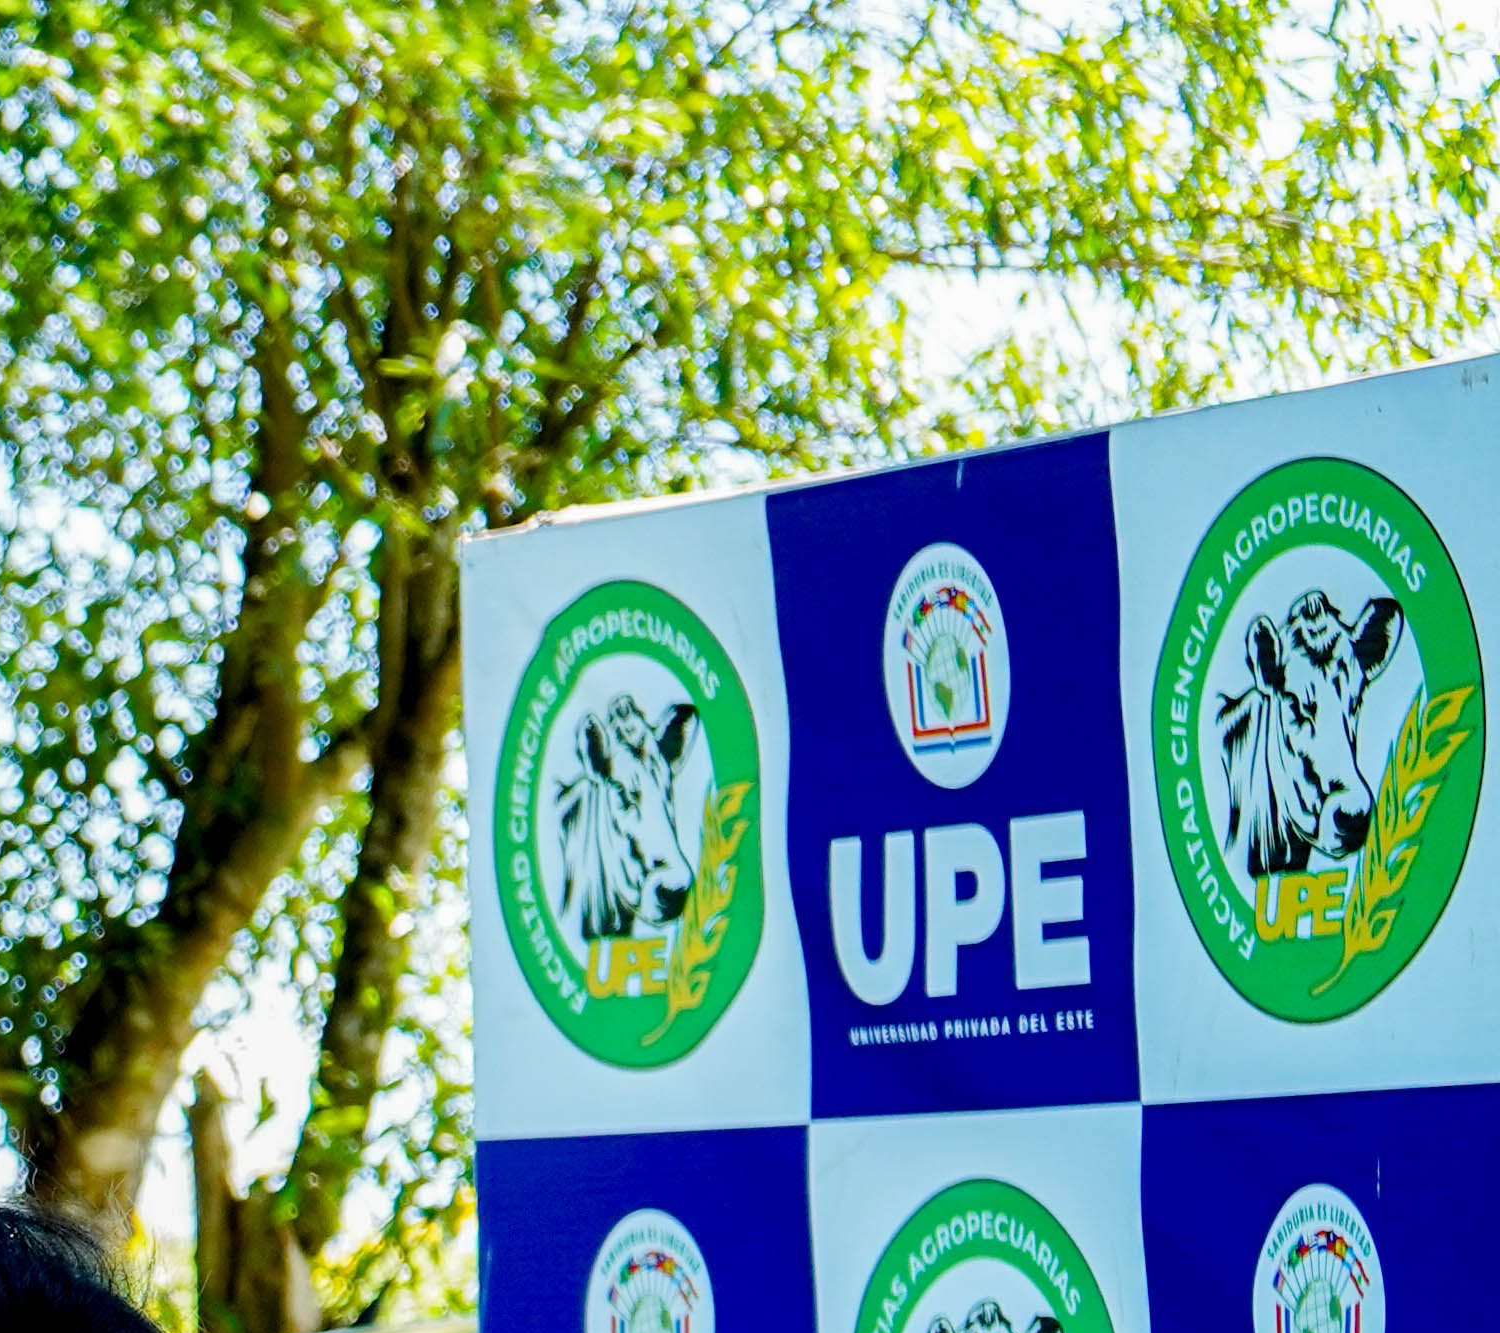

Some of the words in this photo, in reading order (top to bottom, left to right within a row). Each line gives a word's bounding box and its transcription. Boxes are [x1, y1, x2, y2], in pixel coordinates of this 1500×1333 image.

[1223, 493, 1427, 594] AGROPECUARIAS
[556, 608, 721, 702] AGROPECUARIAS
[1171, 575, 1225, 766] CIENCIAS
[507, 674, 560, 844] CIENCIAS
[829, 809, 1092, 1006] UPE
[1172, 781, 1257, 961] FACULTAD
[1254, 866, 1348, 942] UPE
[510, 849, 590, 1016] FACULTAD
[584, 936, 671, 999] UPE
[849, 1021, 938, 1046] UNIVERSIDAD
[944, 1016, 1011, 1039] PRIVADA
[1018, 1013, 1049, 1034] DEL
[1055, 1009, 1094, 1031] ESTE
[906, 1210, 1082, 1318] AGROPECUARIAS
